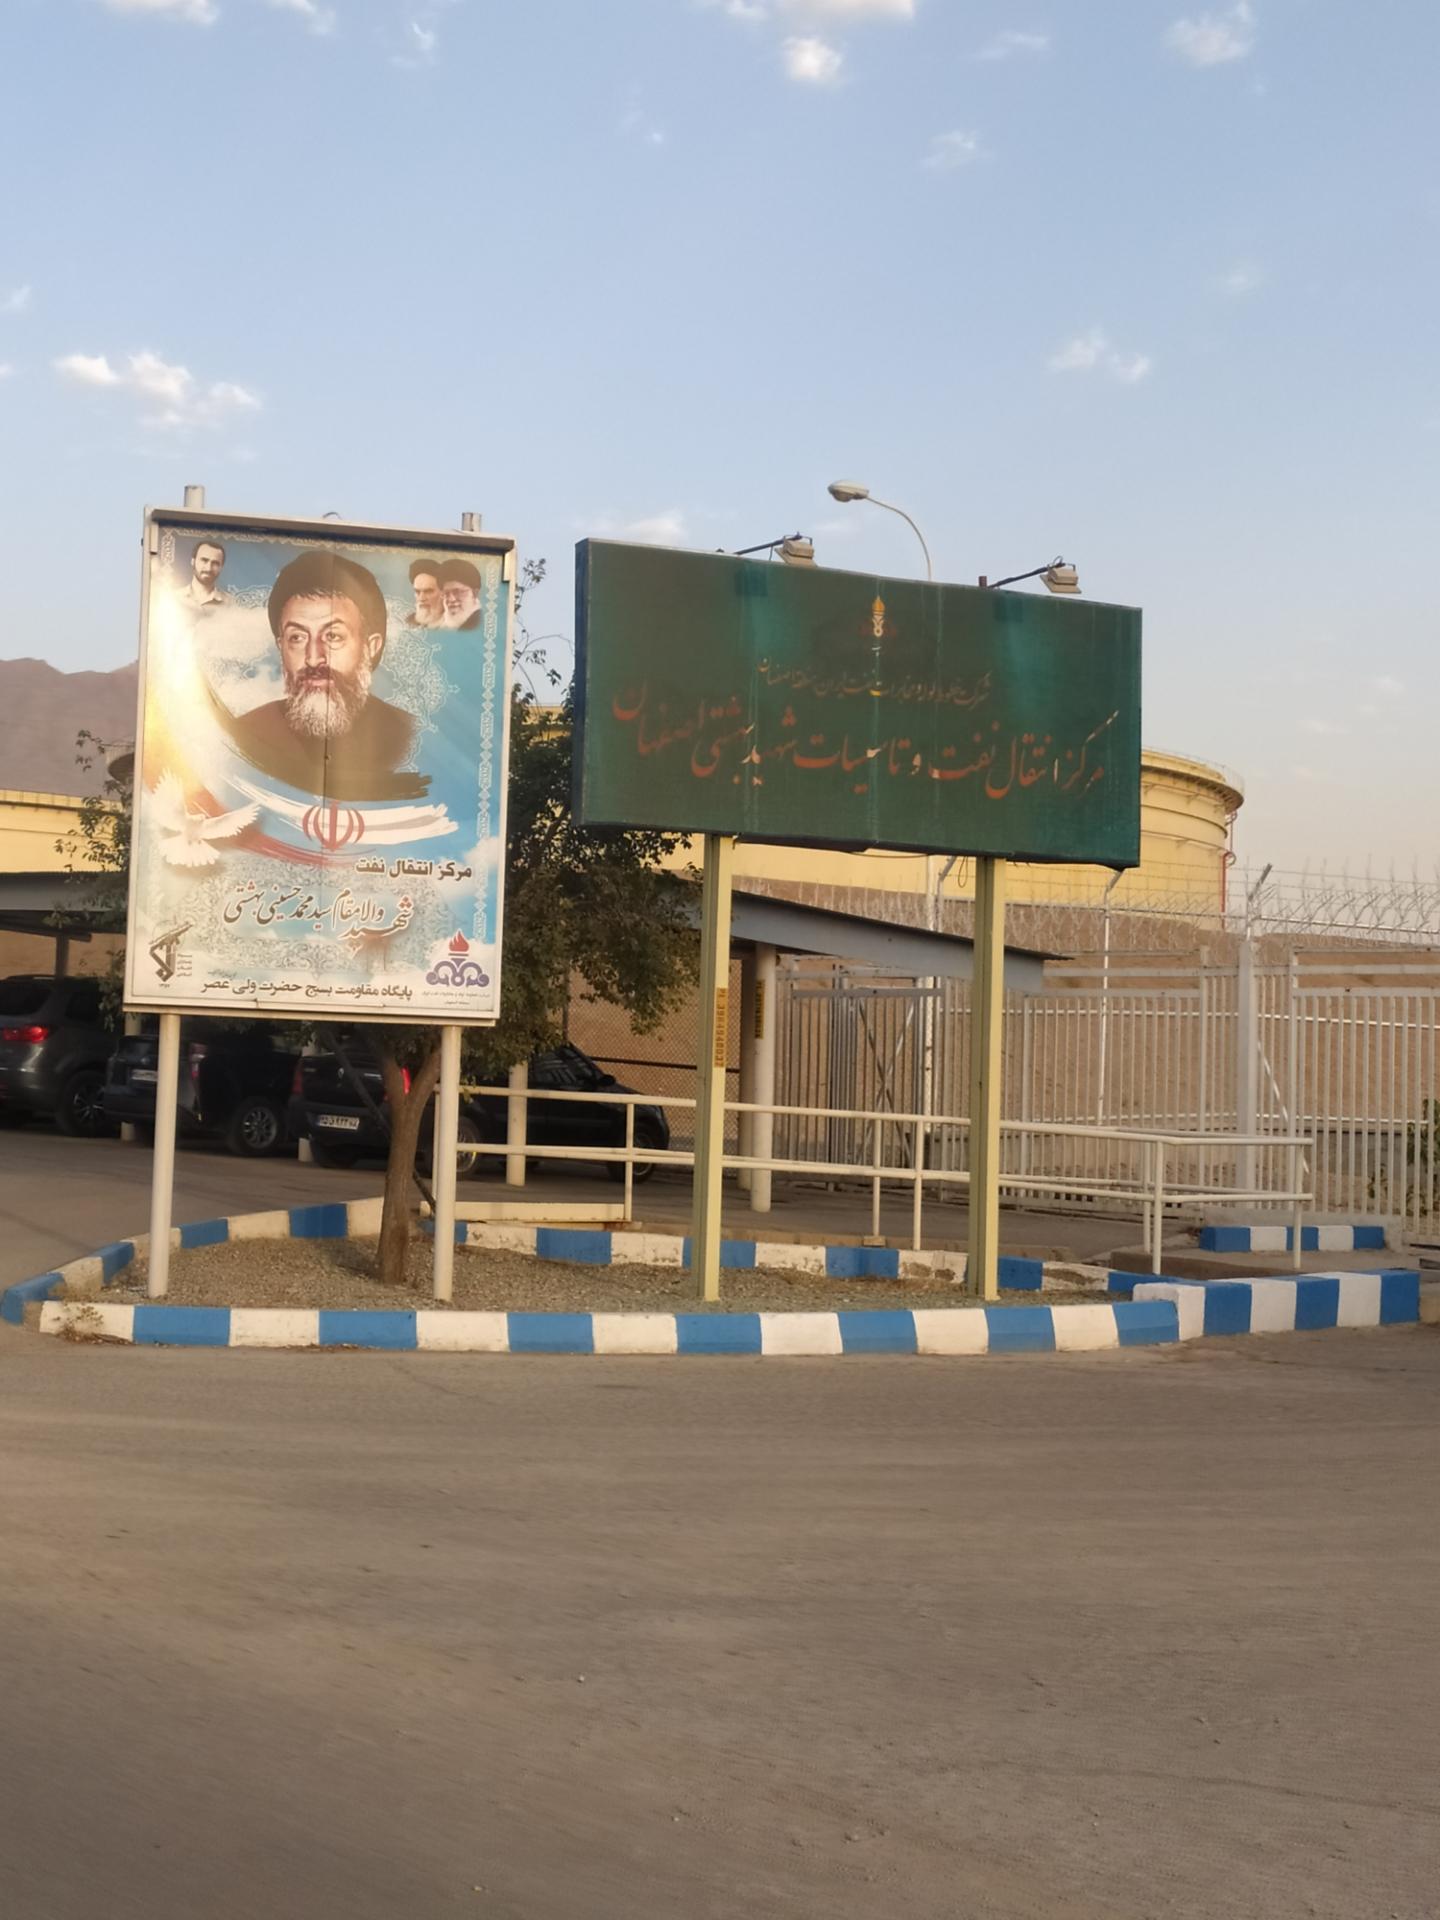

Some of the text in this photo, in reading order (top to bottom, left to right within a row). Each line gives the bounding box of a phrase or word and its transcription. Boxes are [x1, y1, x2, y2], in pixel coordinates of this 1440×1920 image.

[611, 682, 705, 756] اصفهان
[690, 695, 756, 786] بهشتی
[740, 704, 798, 786] شهید
[928, 719, 998, 780] نفت
[1062, 710, 1120, 800] مرکز
[908, 752, 923, 777] و
[985, 734, 1059, 799] انتقال
[356, 857, 473, 881] مرکز انتقال نفت
[223, 880, 265, 924] بهشتی
[256, 886, 302, 925] حسینی
[307, 907, 332, 930] سید
[339, 896, 413, 938] شهید
[201, 979, 230, 994] عصر
[232, 978, 257, 995] ولی
[259, 980, 302, 996] حضرت
[335, 983, 379, 998] مقاومت
[381, 984, 413, 1001] پایگاه
